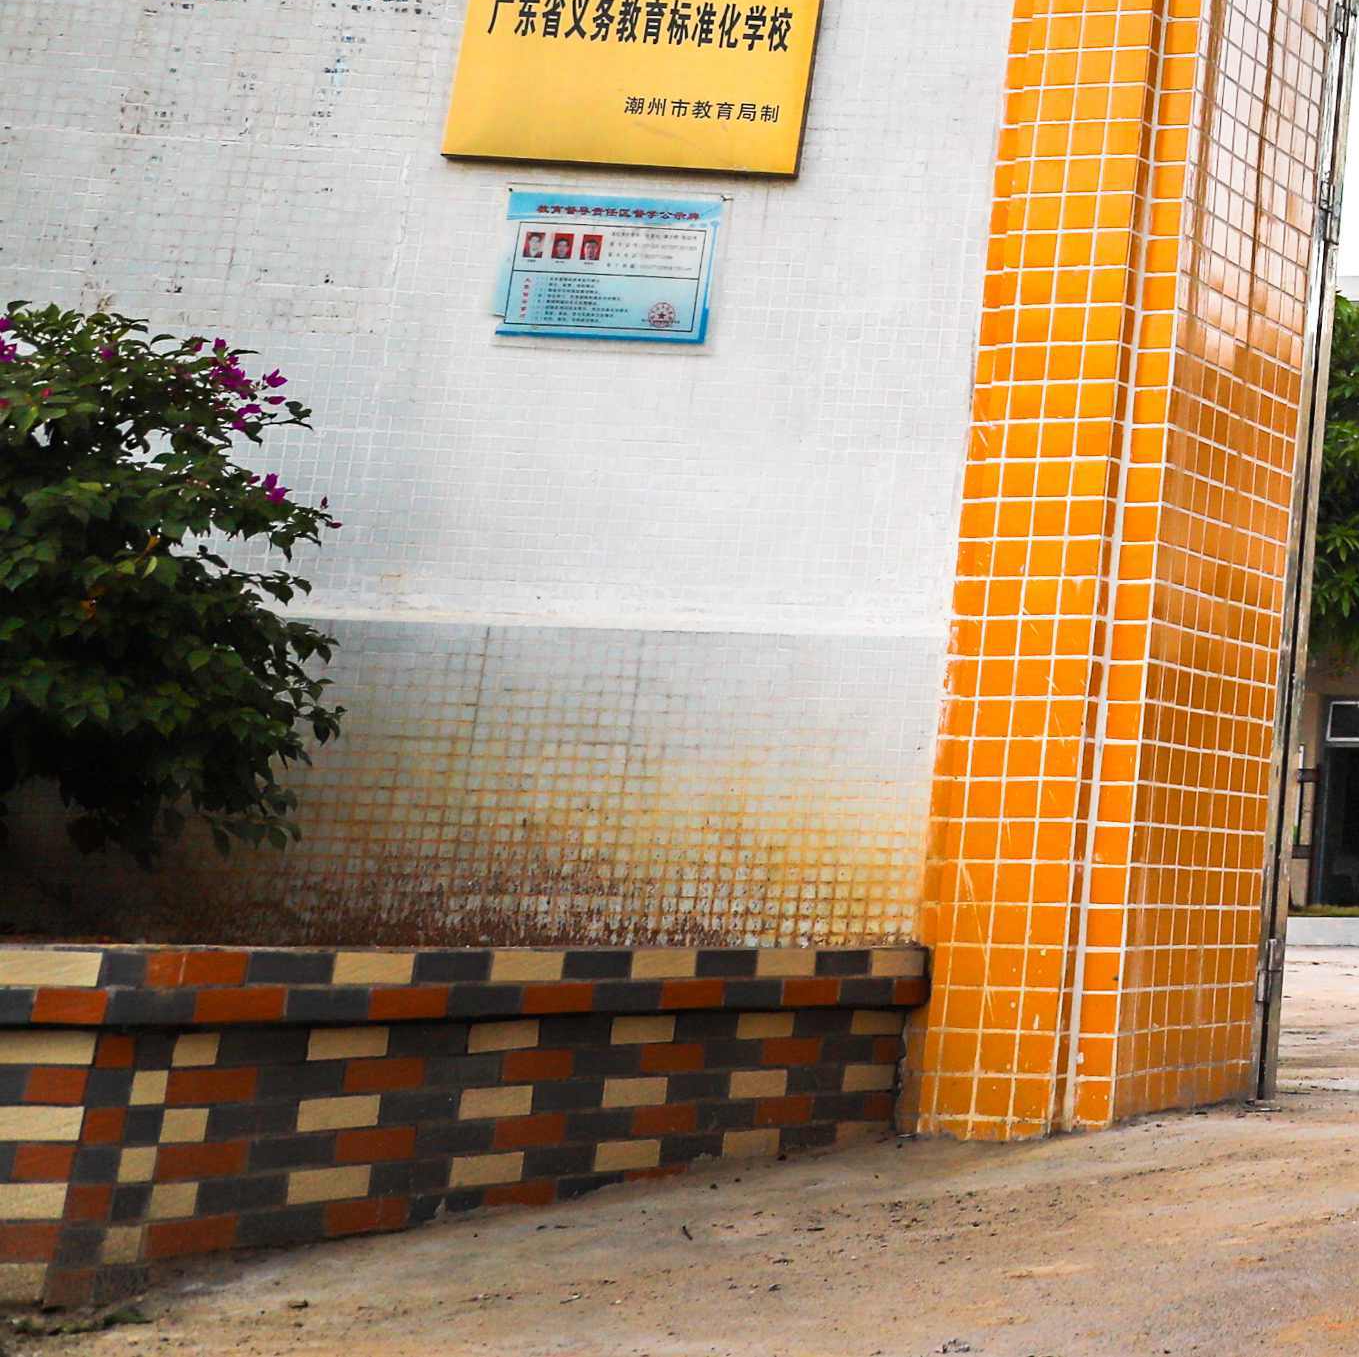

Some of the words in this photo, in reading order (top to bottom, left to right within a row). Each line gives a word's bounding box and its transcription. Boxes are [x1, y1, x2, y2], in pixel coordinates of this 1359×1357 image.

[623, 95, 780, 124] 潮州市教育局制
